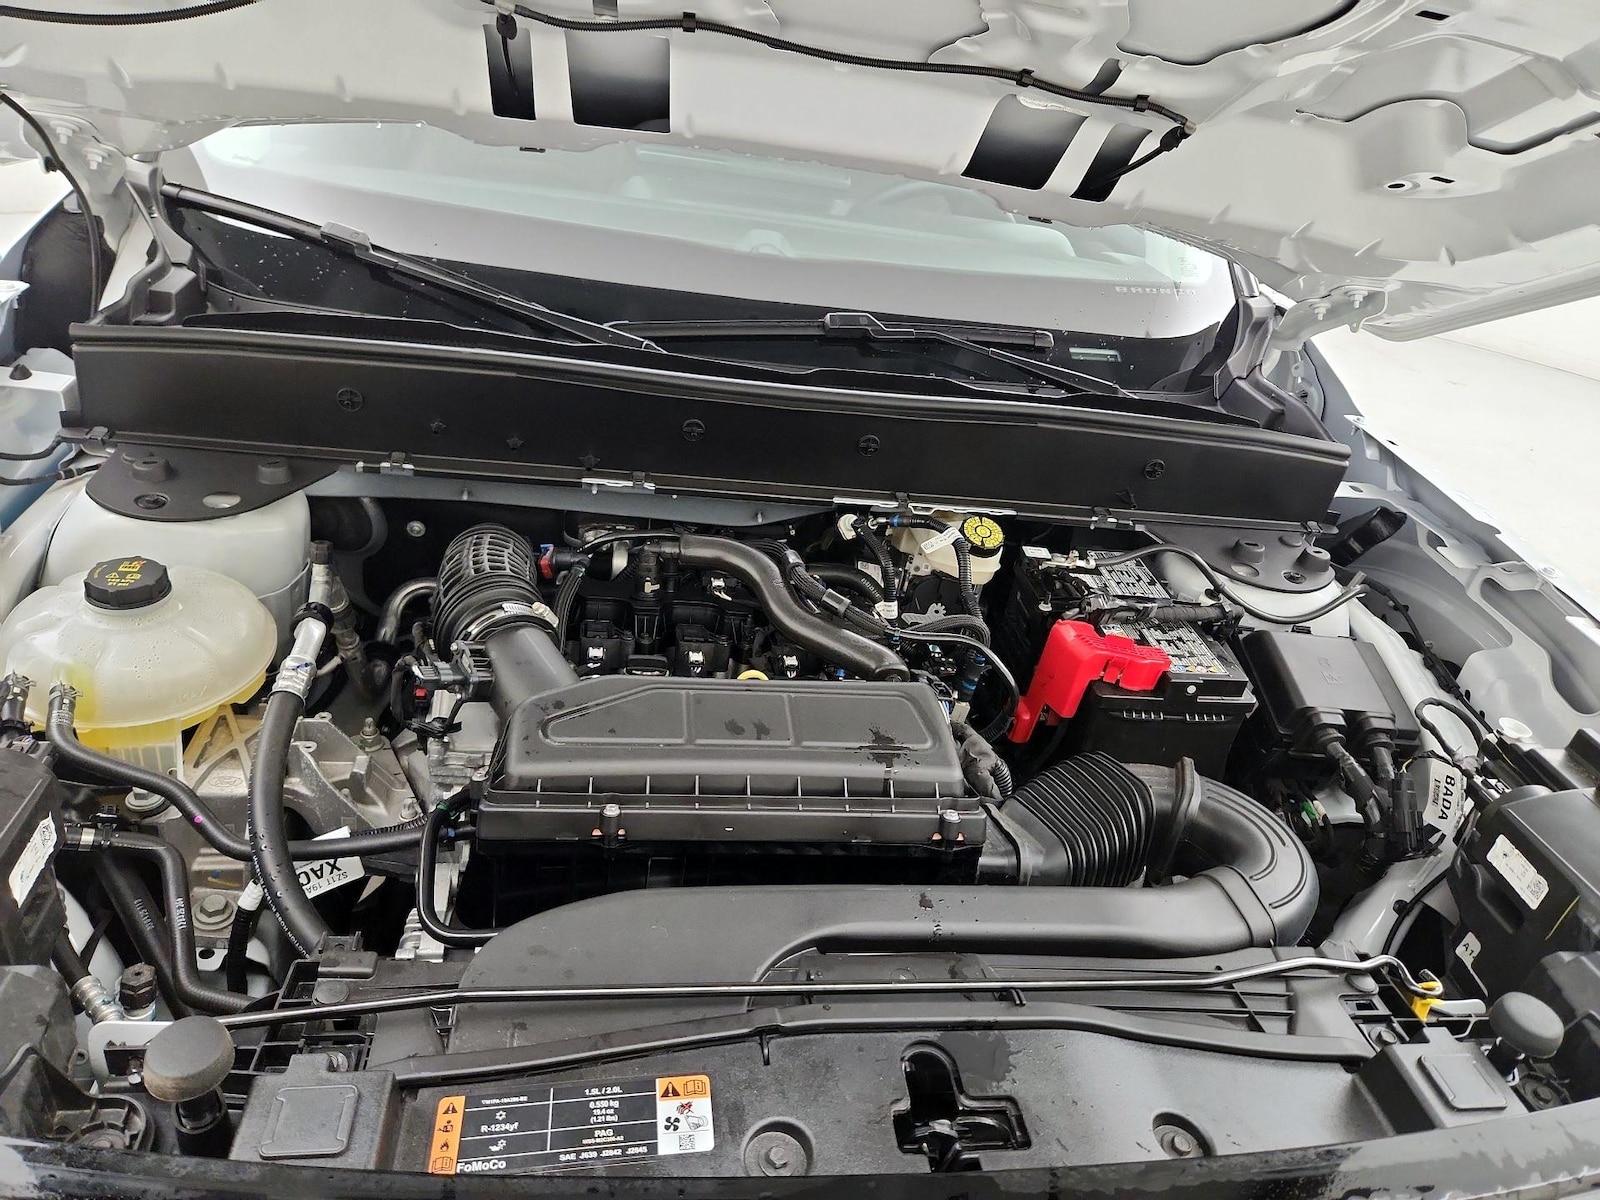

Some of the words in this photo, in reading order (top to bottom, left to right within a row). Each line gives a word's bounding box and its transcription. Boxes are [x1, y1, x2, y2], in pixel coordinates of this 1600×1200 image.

[1438, 774, 1456, 821] BADA
[327, 871, 348, 886] SZ1T
[589, 1100, 609, 1109] 0.550
[610, 1099, 619, 1108] kg
[480, 1121, 519, 1133] R-1234yf
[594, 1129, 614, 1138] PAG
[559, 1152, 577, 1161] SAE
[456, 1159, 506, 1174] FoMoCo
